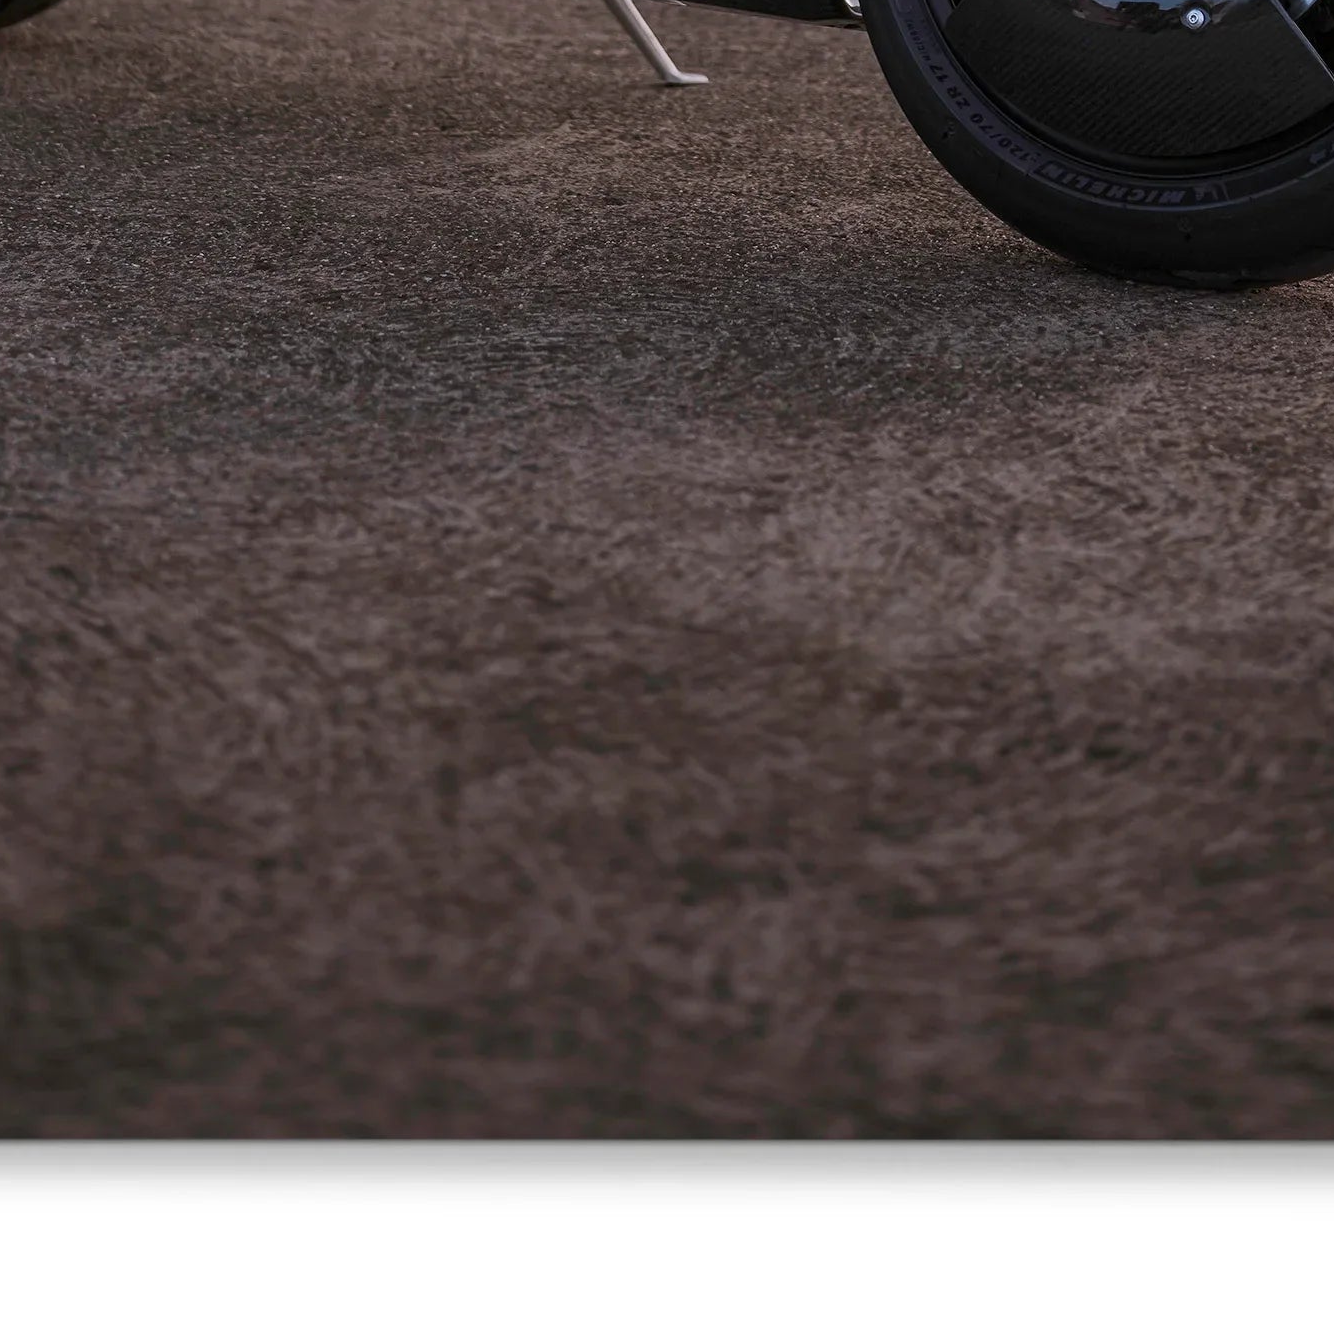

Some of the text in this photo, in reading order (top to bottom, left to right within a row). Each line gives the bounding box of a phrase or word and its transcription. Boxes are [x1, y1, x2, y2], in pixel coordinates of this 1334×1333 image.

[946, 85, 971, 111] ZR
[969, 111, 1028, 163] 120/70
[1036, 162, 1183, 205] MICHELIN
